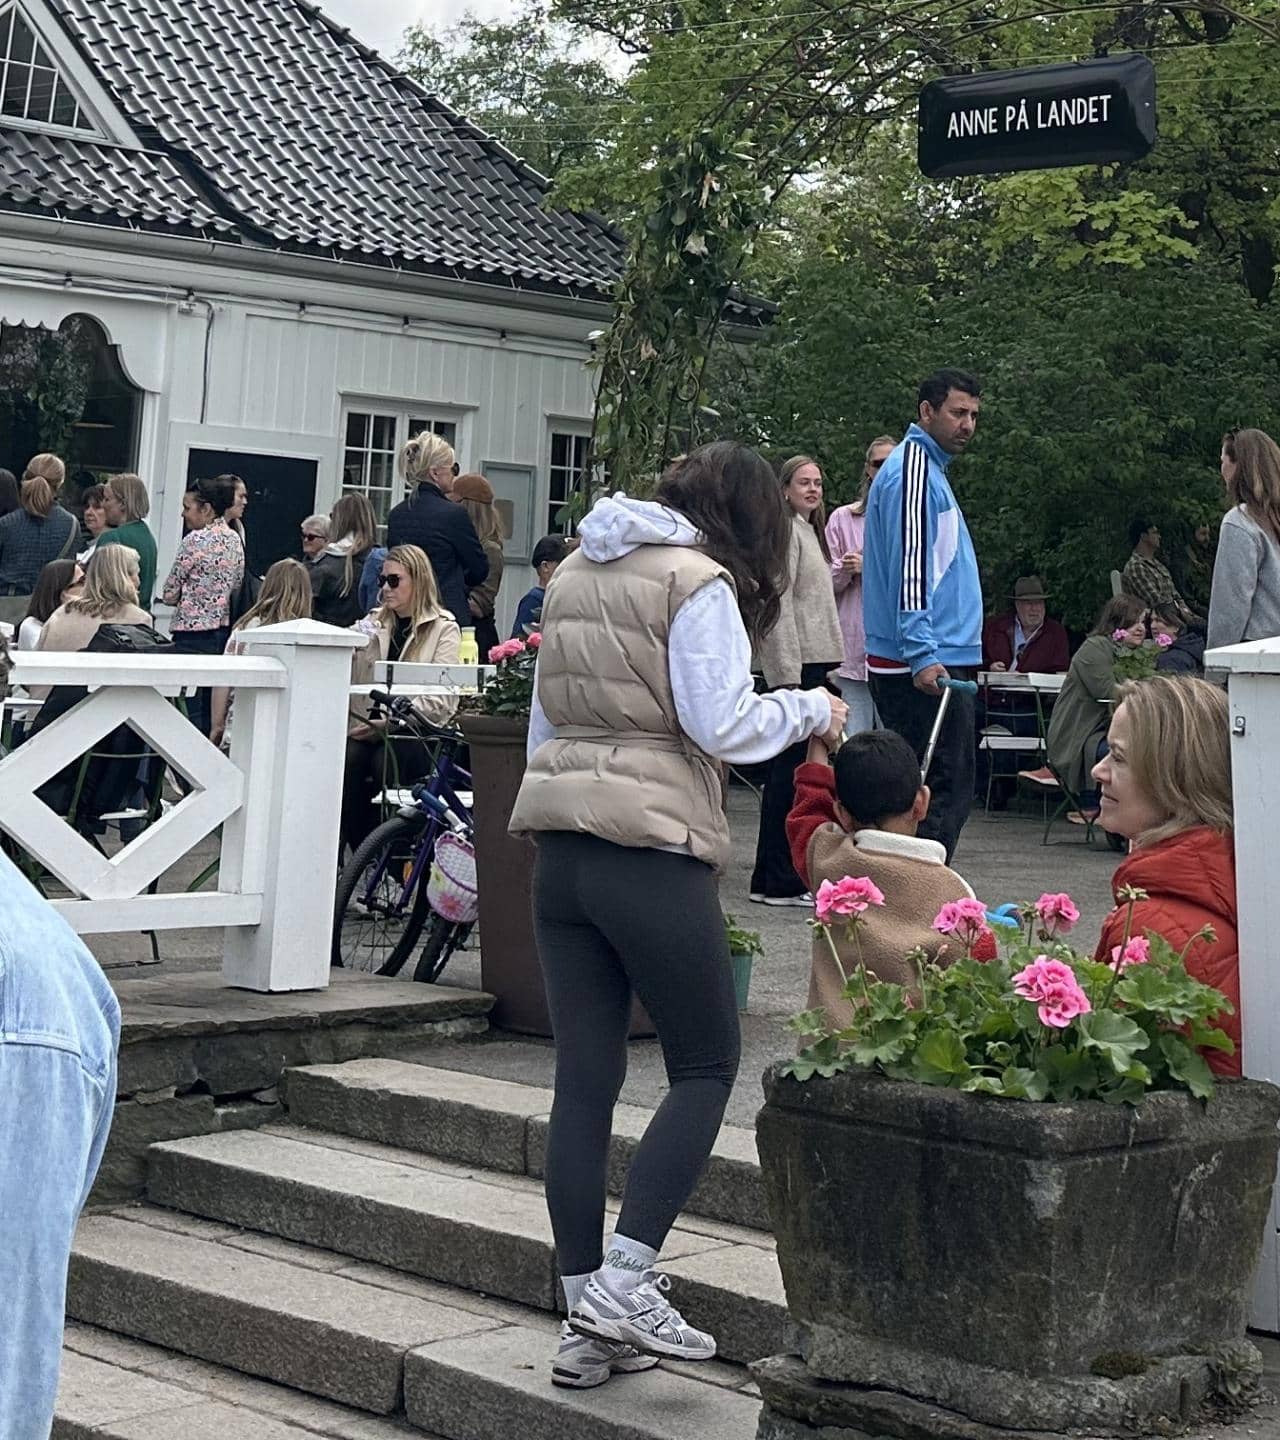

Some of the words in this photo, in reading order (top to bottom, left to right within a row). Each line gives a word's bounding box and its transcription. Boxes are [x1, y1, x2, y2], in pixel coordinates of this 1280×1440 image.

[947, 107, 998, 139] ANNE
[1006, 98, 1029, 131] PÅ
[1037, 94, 1112, 129] LANDET
